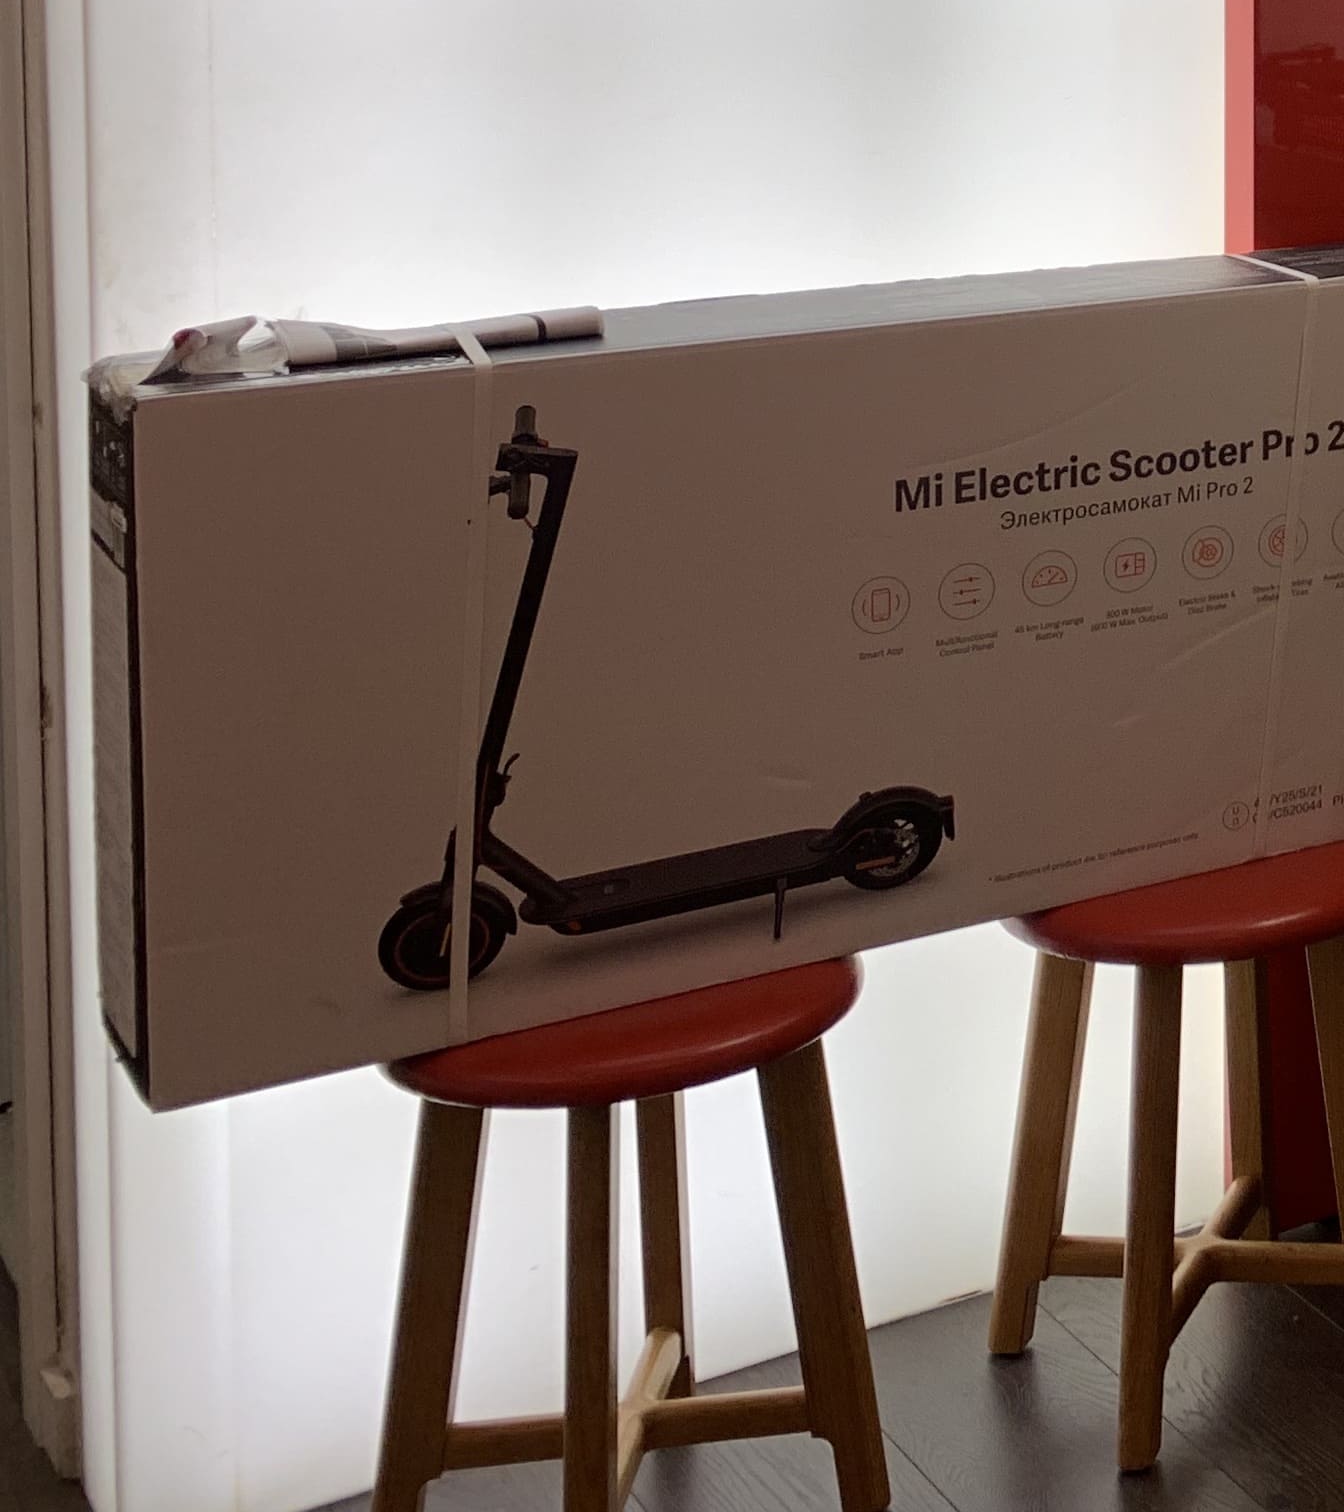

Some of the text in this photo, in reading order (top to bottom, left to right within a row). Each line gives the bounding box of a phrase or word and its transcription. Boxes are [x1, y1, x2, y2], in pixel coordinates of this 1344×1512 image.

[895, 472, 943, 513] Mi
[954, 454, 1101, 505] Electric
[1108, 439, 1254, 483] Scooter
[1262, 428, 1320, 461] Pro
[1000, 476, 1254, 531] Электросамокат Mi Pro 2
